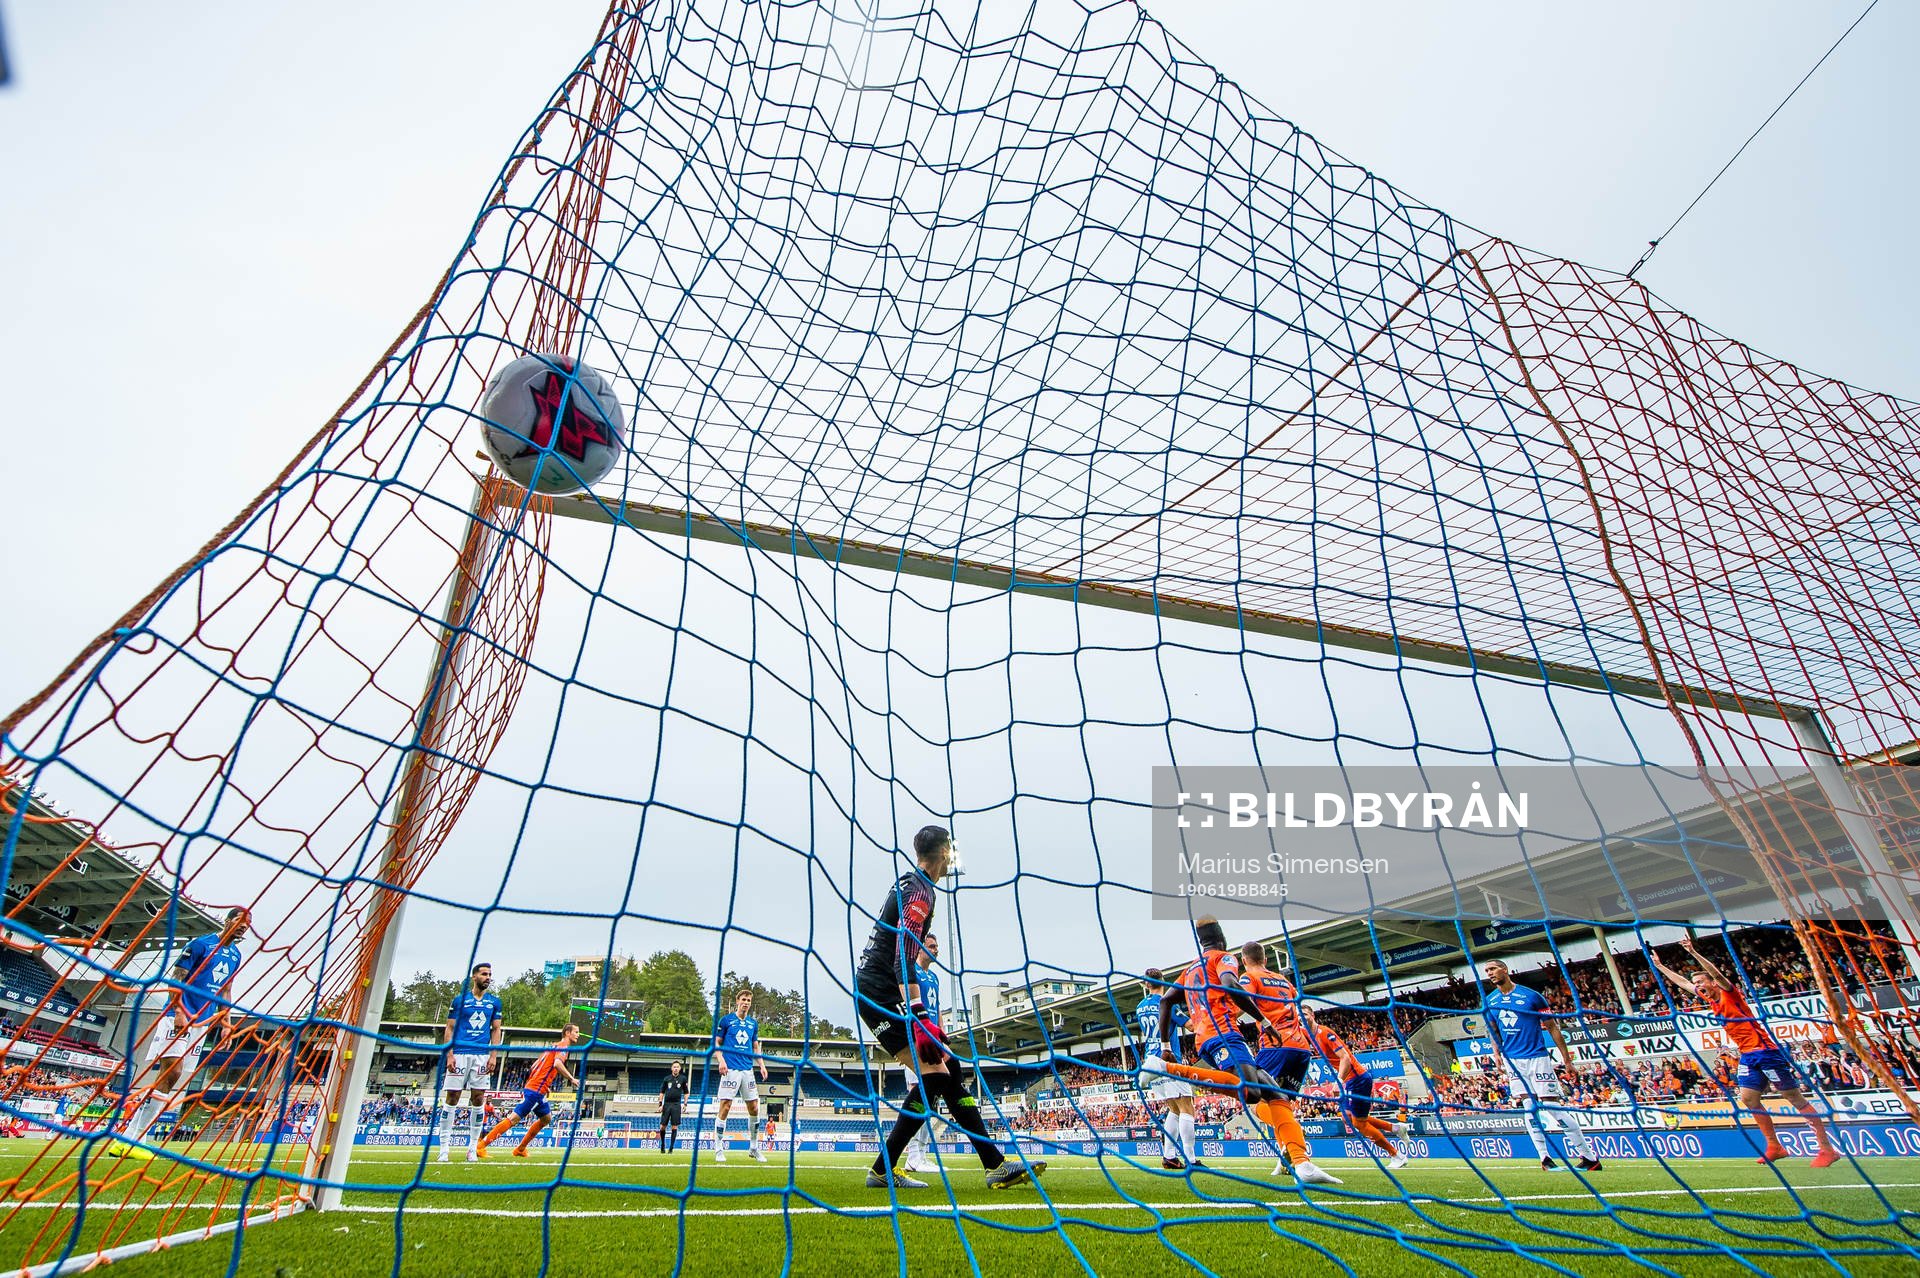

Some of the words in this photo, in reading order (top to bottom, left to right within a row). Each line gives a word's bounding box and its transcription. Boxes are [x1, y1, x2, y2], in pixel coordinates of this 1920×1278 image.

[1636, 881, 1698, 903] Sparebanken
[1140, 1015, 1160, 1041] 22
[1571, 1028, 1608, 1042] OPTMAR
[1634, 1020, 1675, 1035] OPTIMAR
[1638, 1035, 1683, 1055] MAX
[1372, 1059, 1394, 1070] Møre
[1536, 1072, 1556, 1081] BDO
[1425, 1120, 1464, 1132] ÅLEUND
[1466, 1118, 1525, 1131] STORSENTER
[366, 1135, 396, 1145] REMA
[572, 1138, 596, 1148] EMA
[1471, 1137, 1513, 1158] REN
[1638, 1133, 1703, 1158] 1000
[1885, 1127, 1920, 1156] 10
[1203, 1142, 1224, 1157] REN
